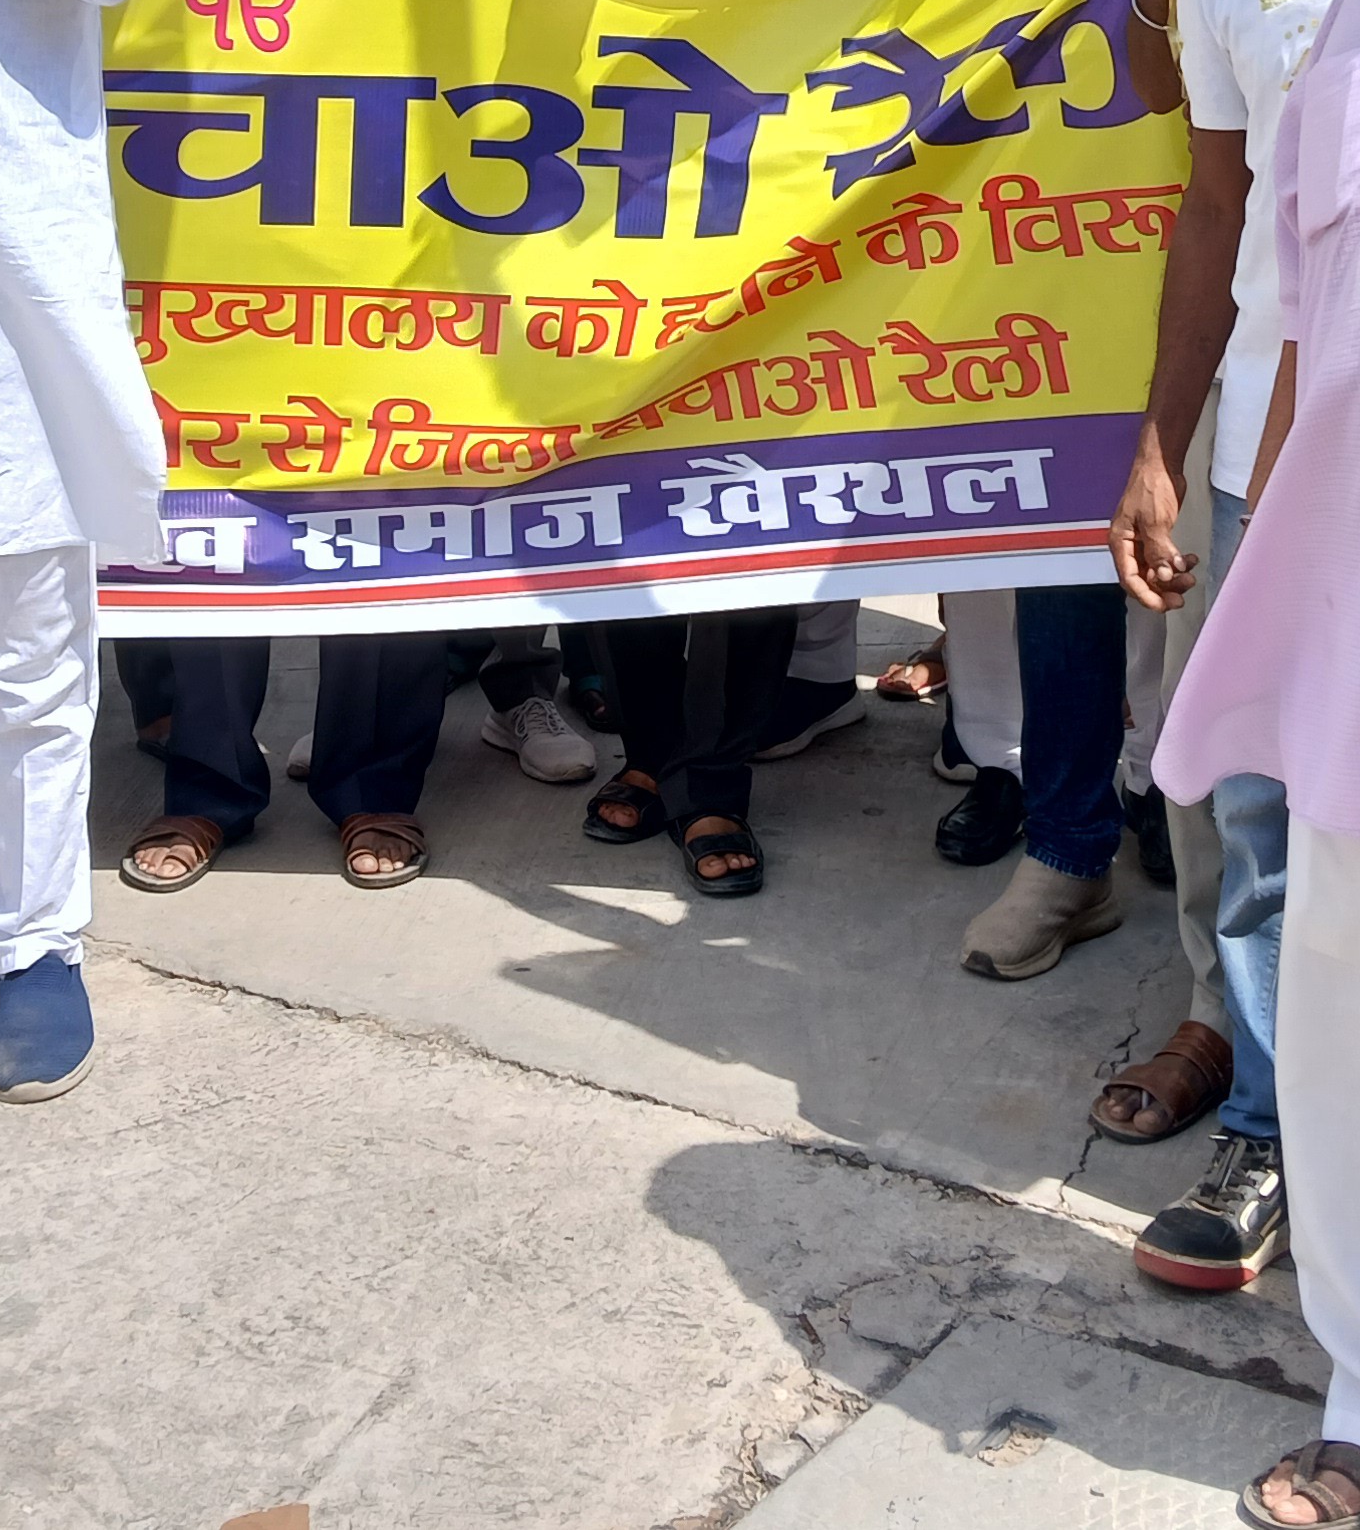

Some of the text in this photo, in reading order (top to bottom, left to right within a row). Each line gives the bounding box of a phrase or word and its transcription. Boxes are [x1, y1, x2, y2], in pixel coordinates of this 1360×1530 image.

[102, 35, 789, 240] चाओ
[525, 278, 649, 358] को
[855, 191, 964, 270] के
[977, 173, 1184, 266] विरू
[260, 395, 352, 474] से
[363, 397, 581, 476] जिला
[877, 312, 1071, 405] रैली
[286, 481, 632, 572] समाज
[659, 448, 1056, 539] खैरथल
